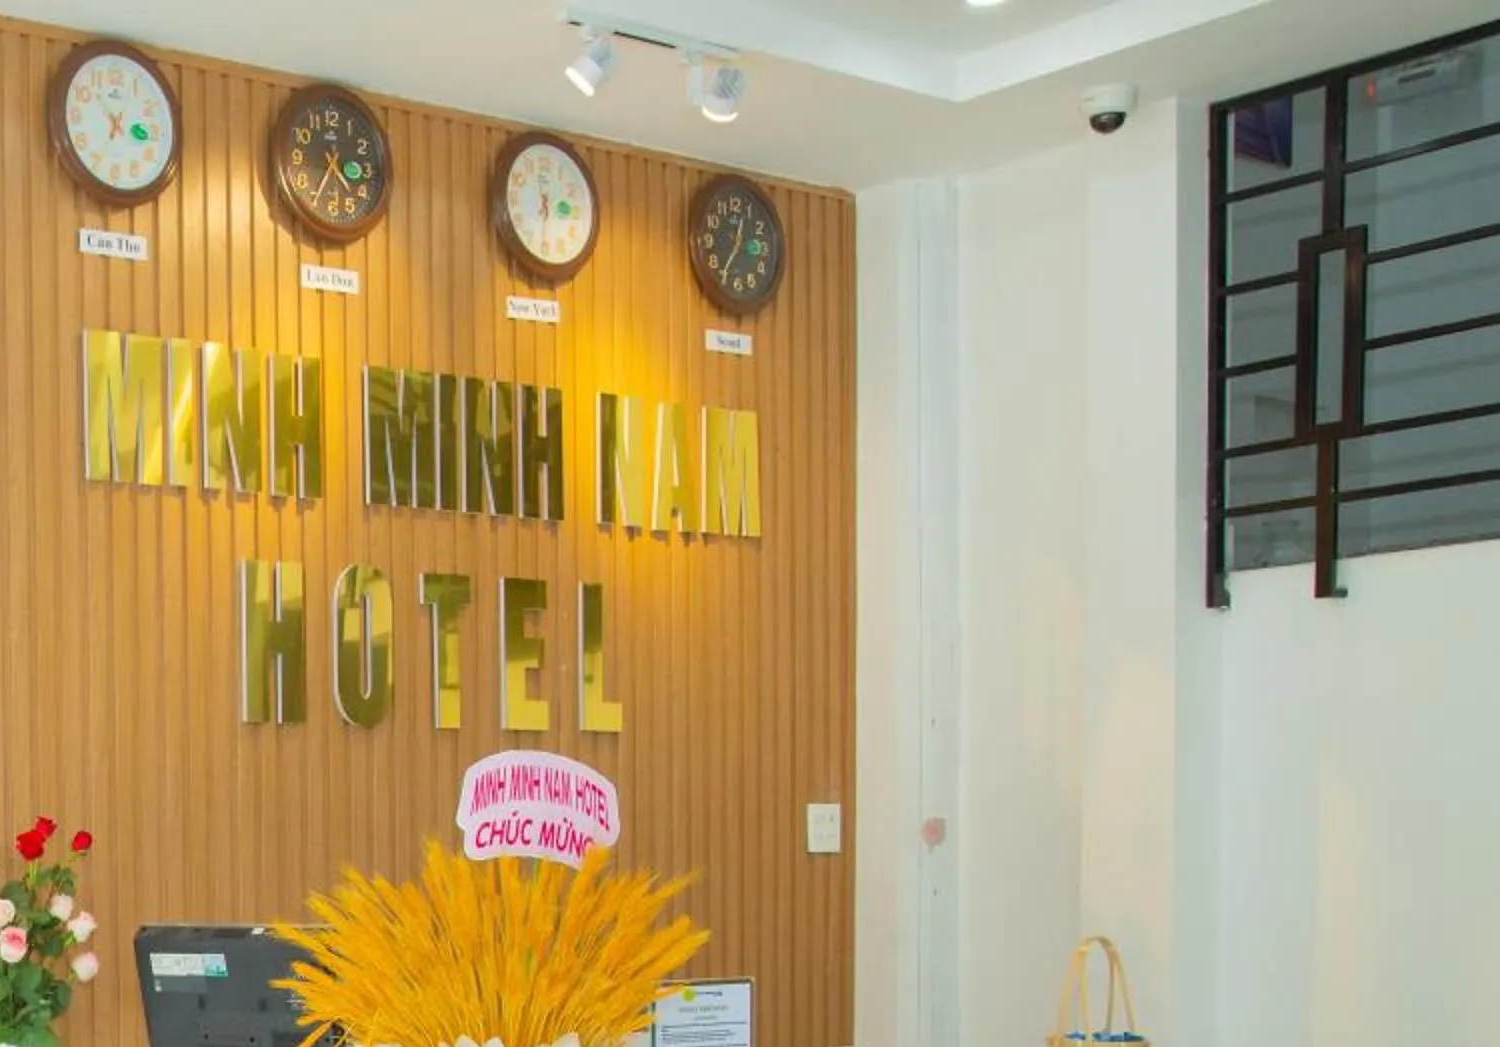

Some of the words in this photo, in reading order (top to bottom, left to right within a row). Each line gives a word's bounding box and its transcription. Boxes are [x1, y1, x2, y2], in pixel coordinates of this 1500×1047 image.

[309, 113, 321, 129] 11
[325, 110, 339, 127] 12
[294, 128, 311, 145] 10
[357, 139, 369, 155] 2
[292, 149, 303, 165] 9
[296, 173, 308, 189] 8
[345, 198, 356, 214] 5
[718, 201, 727, 216] 11
[730, 198, 741, 213] 12
[707, 215, 719, 229] 10
[756, 221, 764, 235] 2
[704, 234, 713, 249] 9
[708, 255, 718, 269] 8
[734, 278, 743, 291] 6
[82, 328, 322, 498] MINH
[363, 364, 564, 520] MINH
[596, 391, 761, 537] NAM
[241, 557, 623, 732] HOTEL
[470, 767, 507, 816] MINH
[510, 765, 541, 801] MINH
[544, 767, 572, 806] NAM
[575, 773, 611, 833] HOTEL
[475, 810, 533, 849] CHÚC
